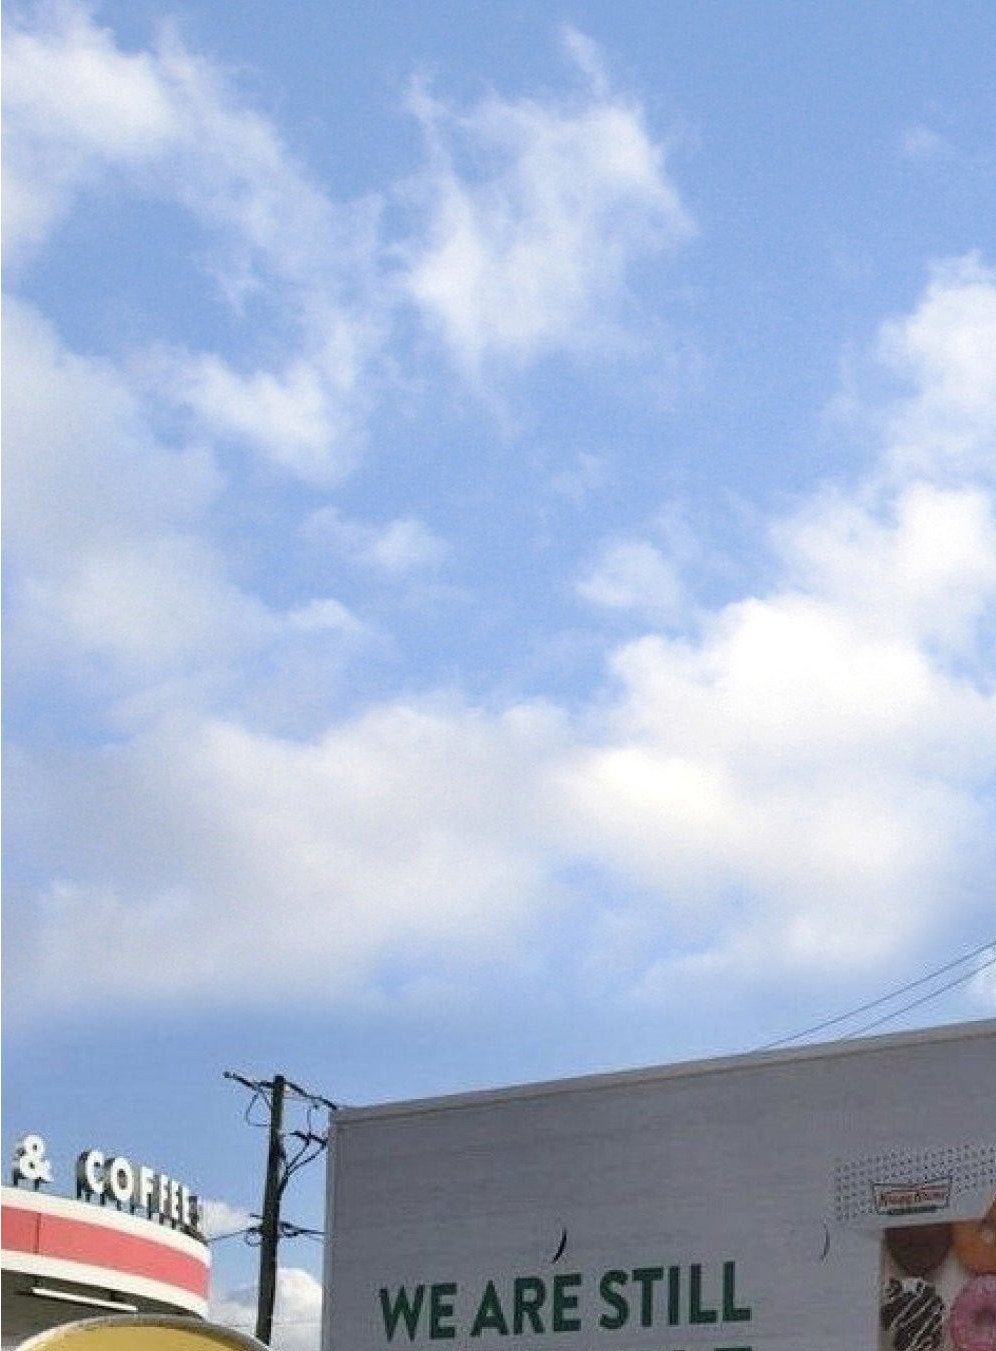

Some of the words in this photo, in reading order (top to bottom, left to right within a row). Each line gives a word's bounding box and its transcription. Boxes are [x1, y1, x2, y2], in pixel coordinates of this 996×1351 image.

[15, 1134, 54, 1183] &
[379, 1282, 457, 1342] WE
[470, 1273, 582, 1337] ARE
[598, 1260, 752, 1330] STILL
